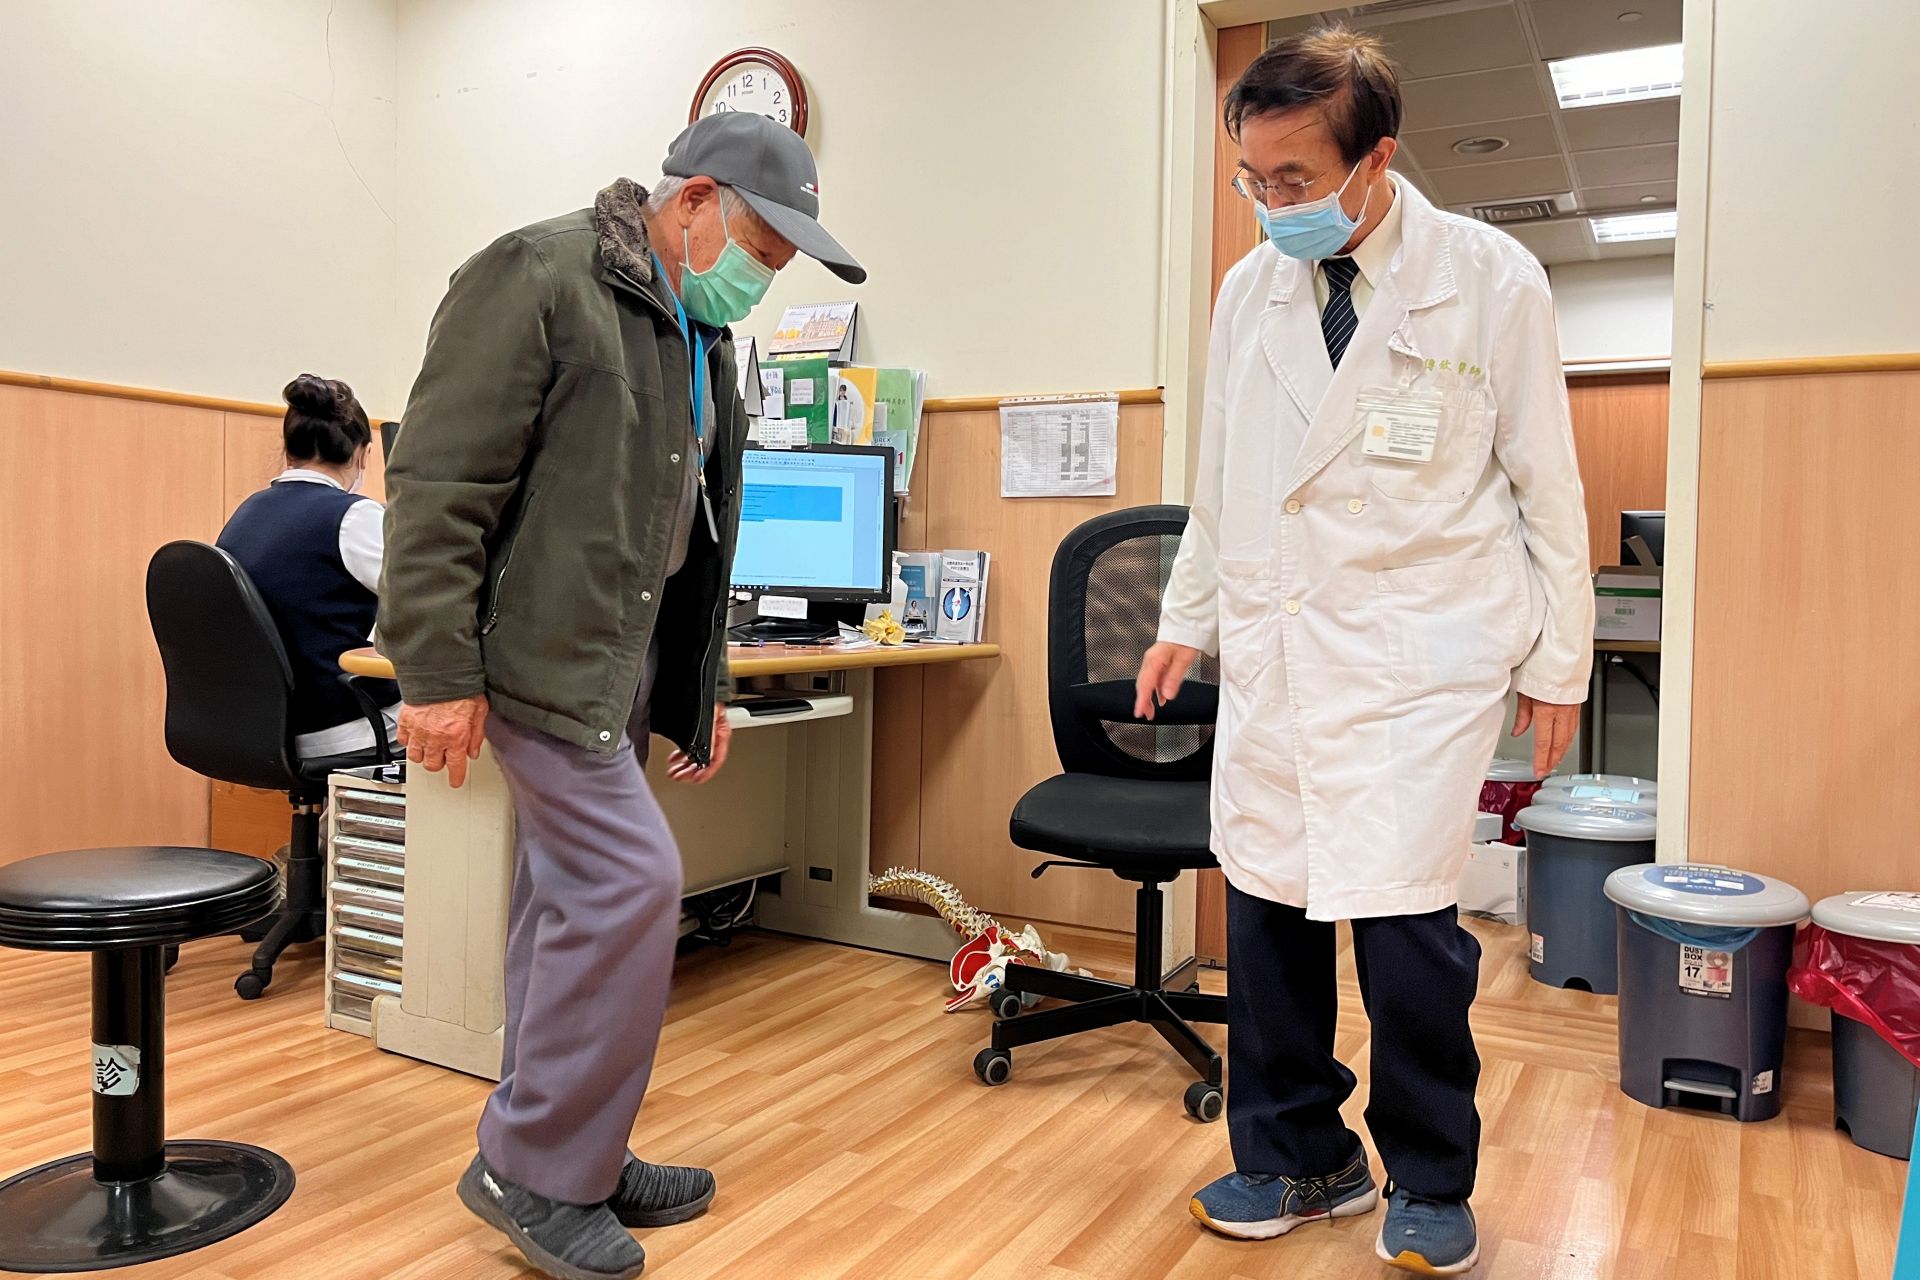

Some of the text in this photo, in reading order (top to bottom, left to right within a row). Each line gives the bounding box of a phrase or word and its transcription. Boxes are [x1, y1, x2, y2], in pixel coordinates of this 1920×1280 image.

[742, 74, 753, 87] 12
[763, 77, 767, 90] 1
[727, 84, 737, 97] 11
[773, 91, 781, 104] 2
[715, 101, 727, 113] 10
[779, 109, 787, 122] 3
[1684, 946, 1703, 954] DUST
[1684, 953, 1703, 961] BOX
[1684, 965, 1701, 978] 17
[95, 1057, 128, 1092] 診
